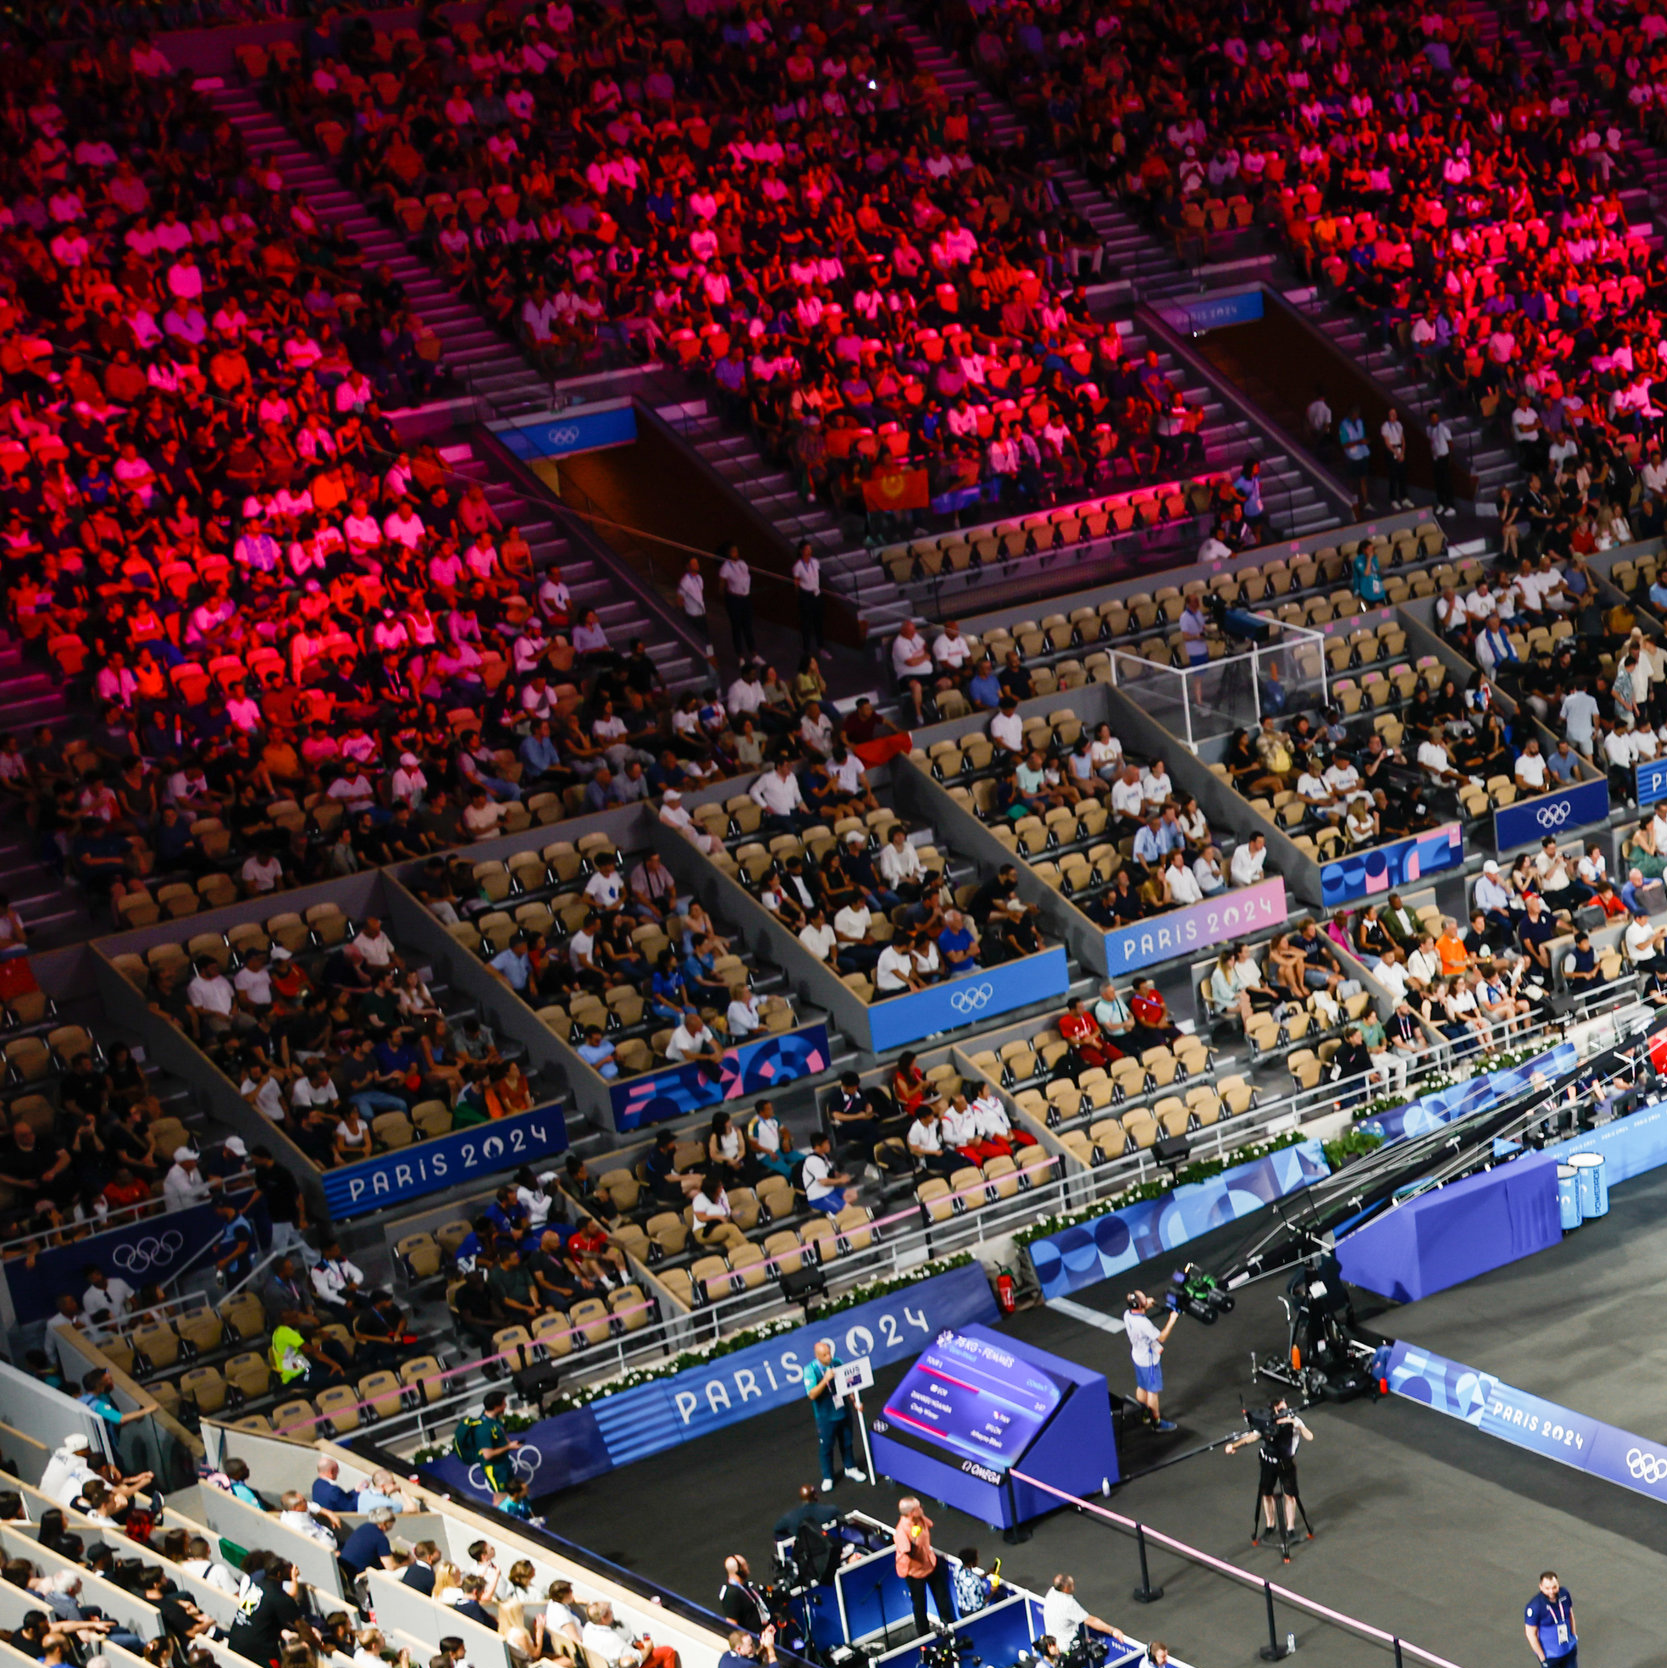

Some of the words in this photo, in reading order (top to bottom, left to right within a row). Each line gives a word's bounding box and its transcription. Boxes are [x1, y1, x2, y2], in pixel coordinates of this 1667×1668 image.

[1208, 897, 1272, 934] 2024
[461, 1124, 547, 1167] 2024
[1493, 1401, 1539, 1432] PARIS
[1541, 1421, 1583, 1450] 2024
[971, 1463, 1001, 1485] OMEGA
